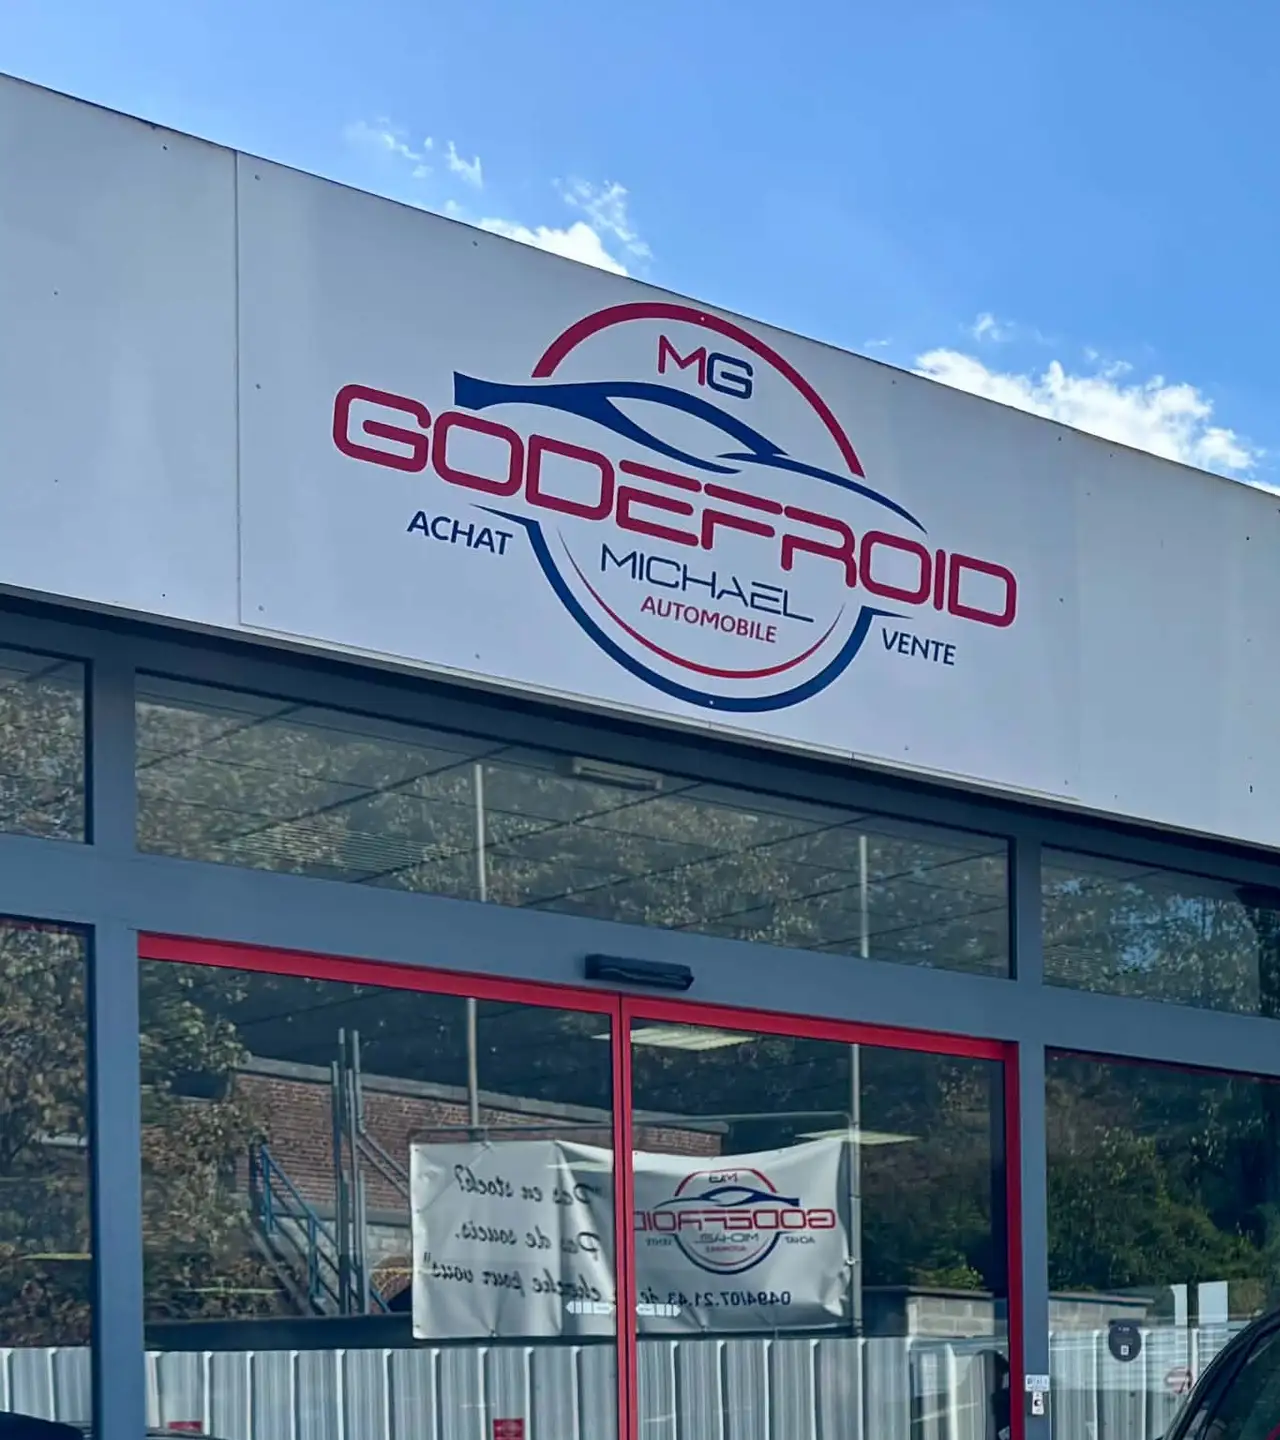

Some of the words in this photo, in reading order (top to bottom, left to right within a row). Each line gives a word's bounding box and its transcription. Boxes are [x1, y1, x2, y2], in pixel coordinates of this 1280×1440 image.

[657, 334, 754, 400] MG
[332, 383, 1018, 629] GODEFROID
[406, 509, 514, 557] ACHAT
[600, 542, 815, 624] MICHAEL
[640, 594, 778, 645] AUTOMOBILE
[880, 626, 957, 667] VENTE
